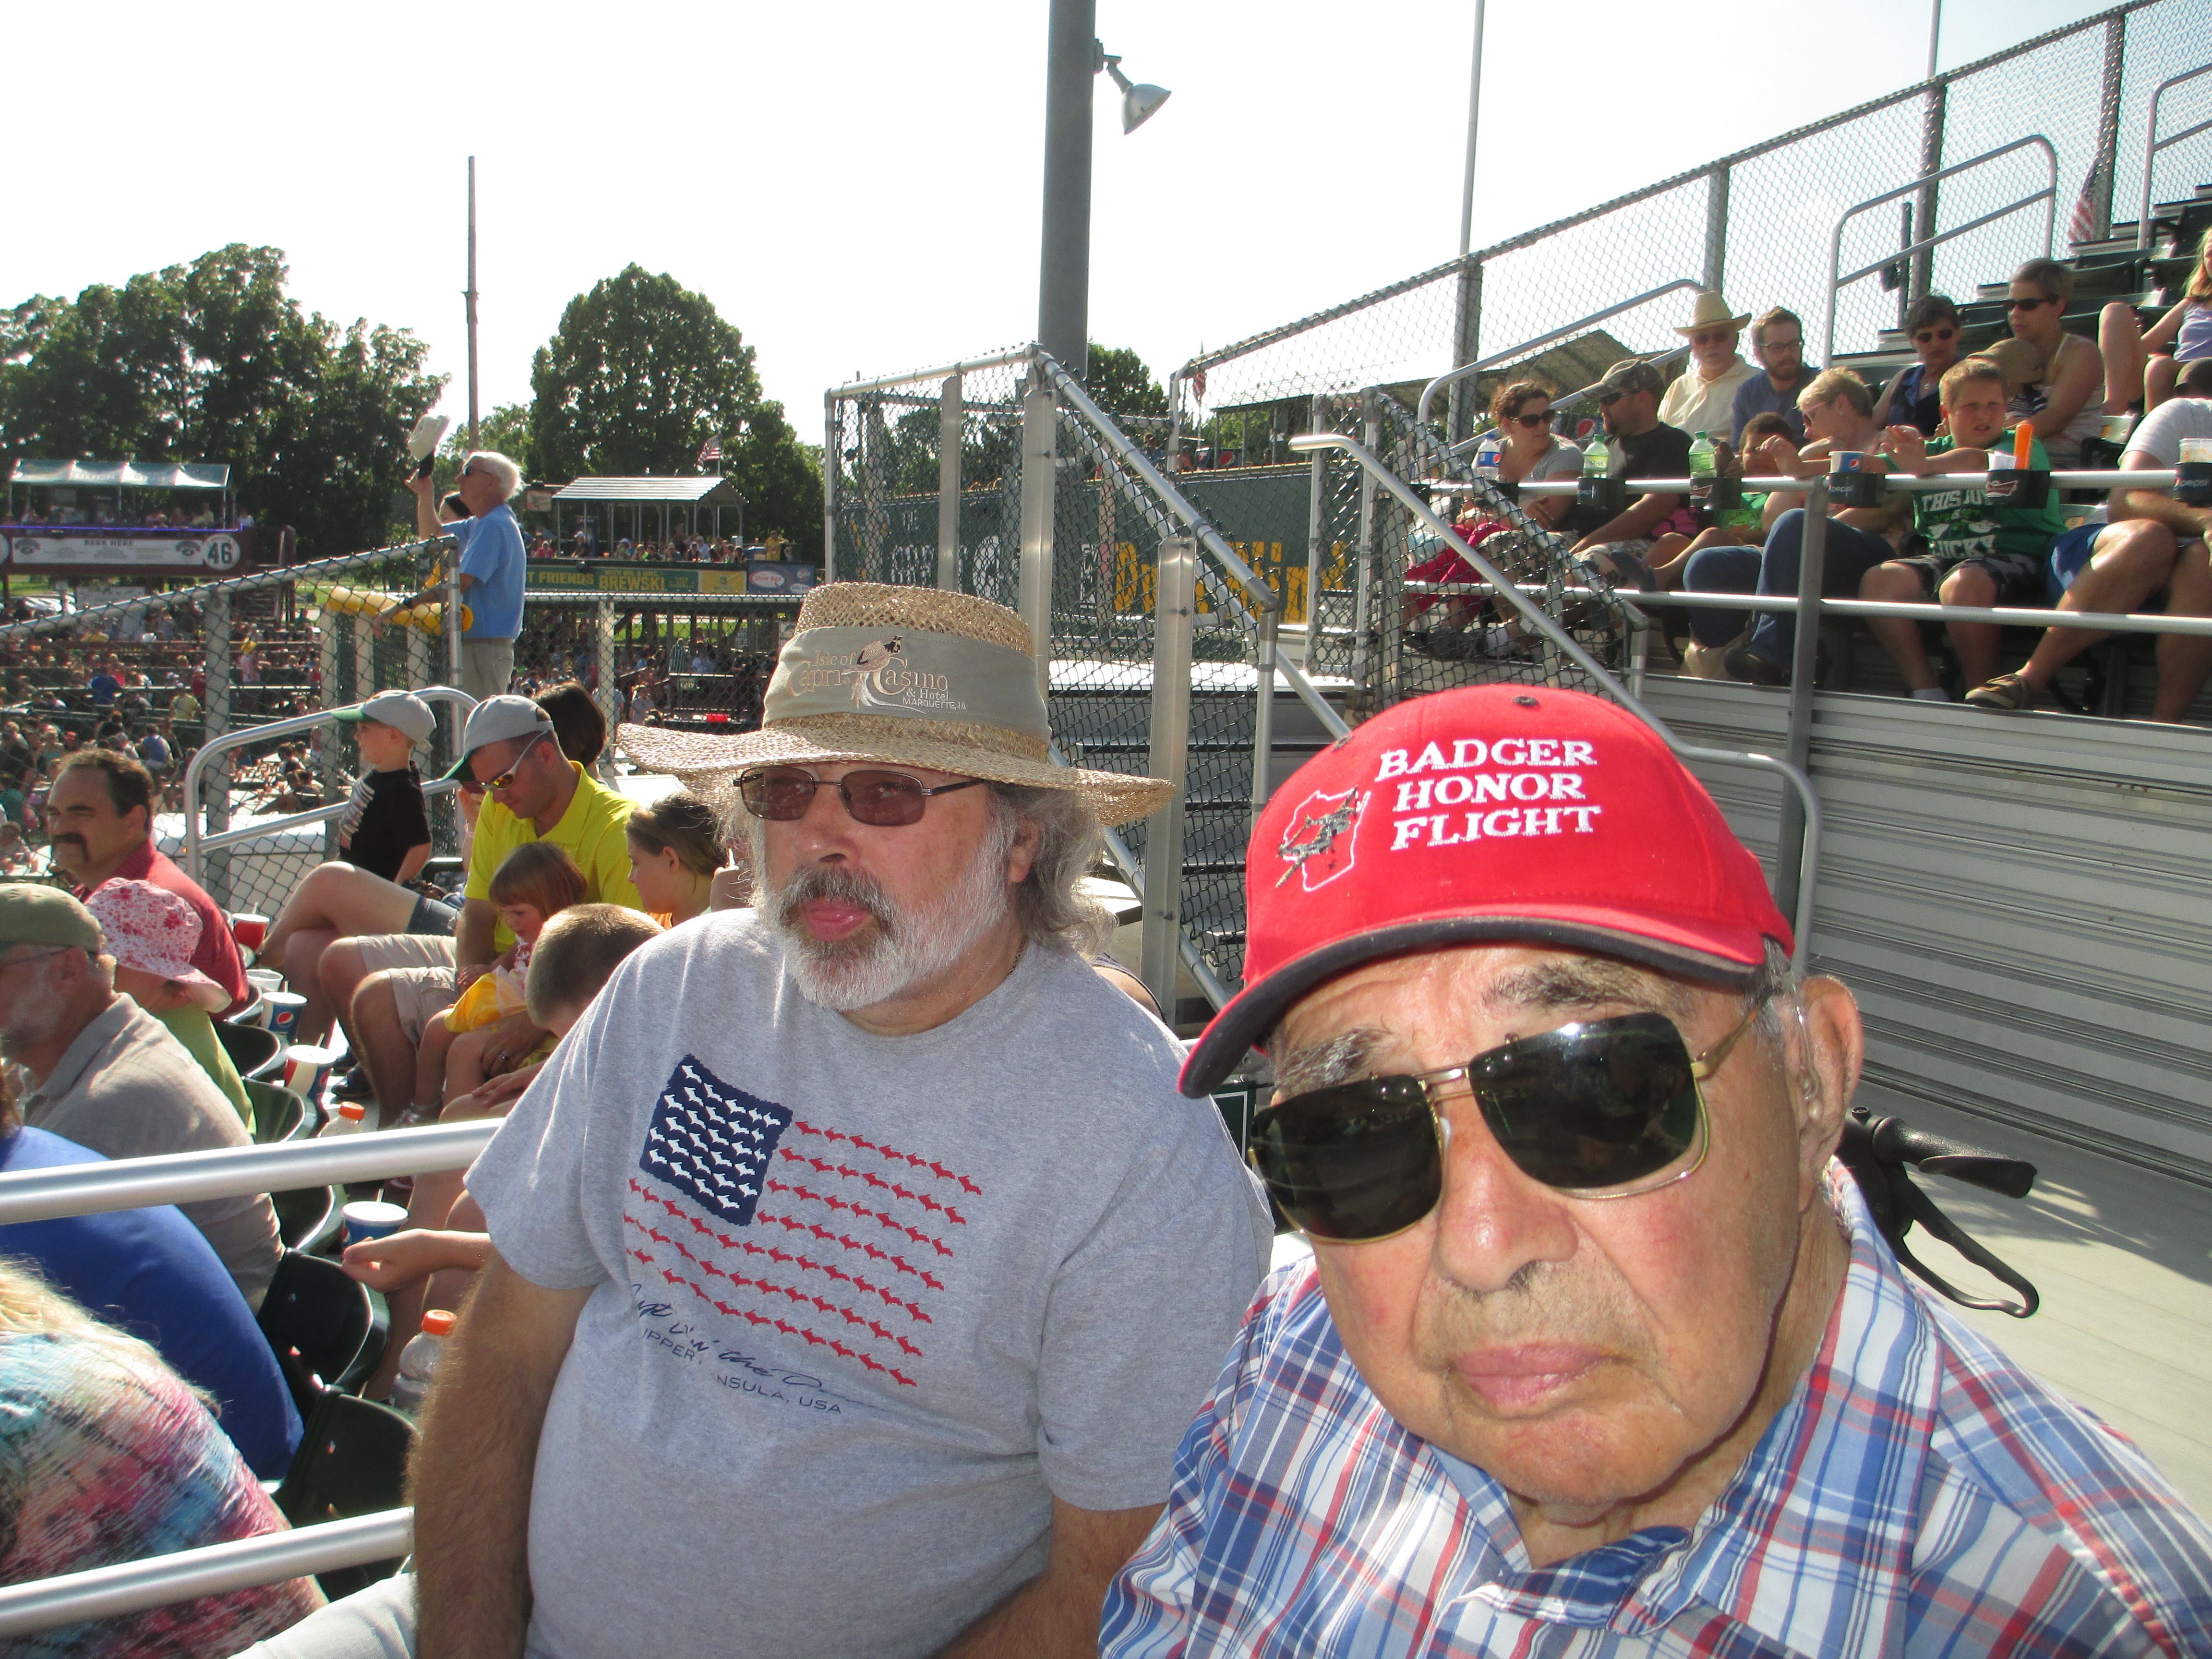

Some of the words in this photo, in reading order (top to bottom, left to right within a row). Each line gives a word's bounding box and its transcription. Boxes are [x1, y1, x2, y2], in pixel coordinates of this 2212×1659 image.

[1922, 490, 1961, 513] THIS
[208, 542, 232, 564] 46
[539, 572, 594, 585] FRIENDS
[599, 575, 665, 591] BREWSKI
[815, 650, 837, 667] Isle
[840, 653, 856, 666] of
[786, 660, 842, 697] Capri
[872, 656, 949, 696] Casino
[906, 687, 916, 697] &
[920, 688, 949, 701] Hotel
[1374, 738, 1599, 782] BADGER
[1392, 773, 1586, 812] HONOR
[1390, 806, 1602, 851] FLIGHT
[642, 1328, 695, 1362] PPER
[799, 1396, 842, 1414] USA
